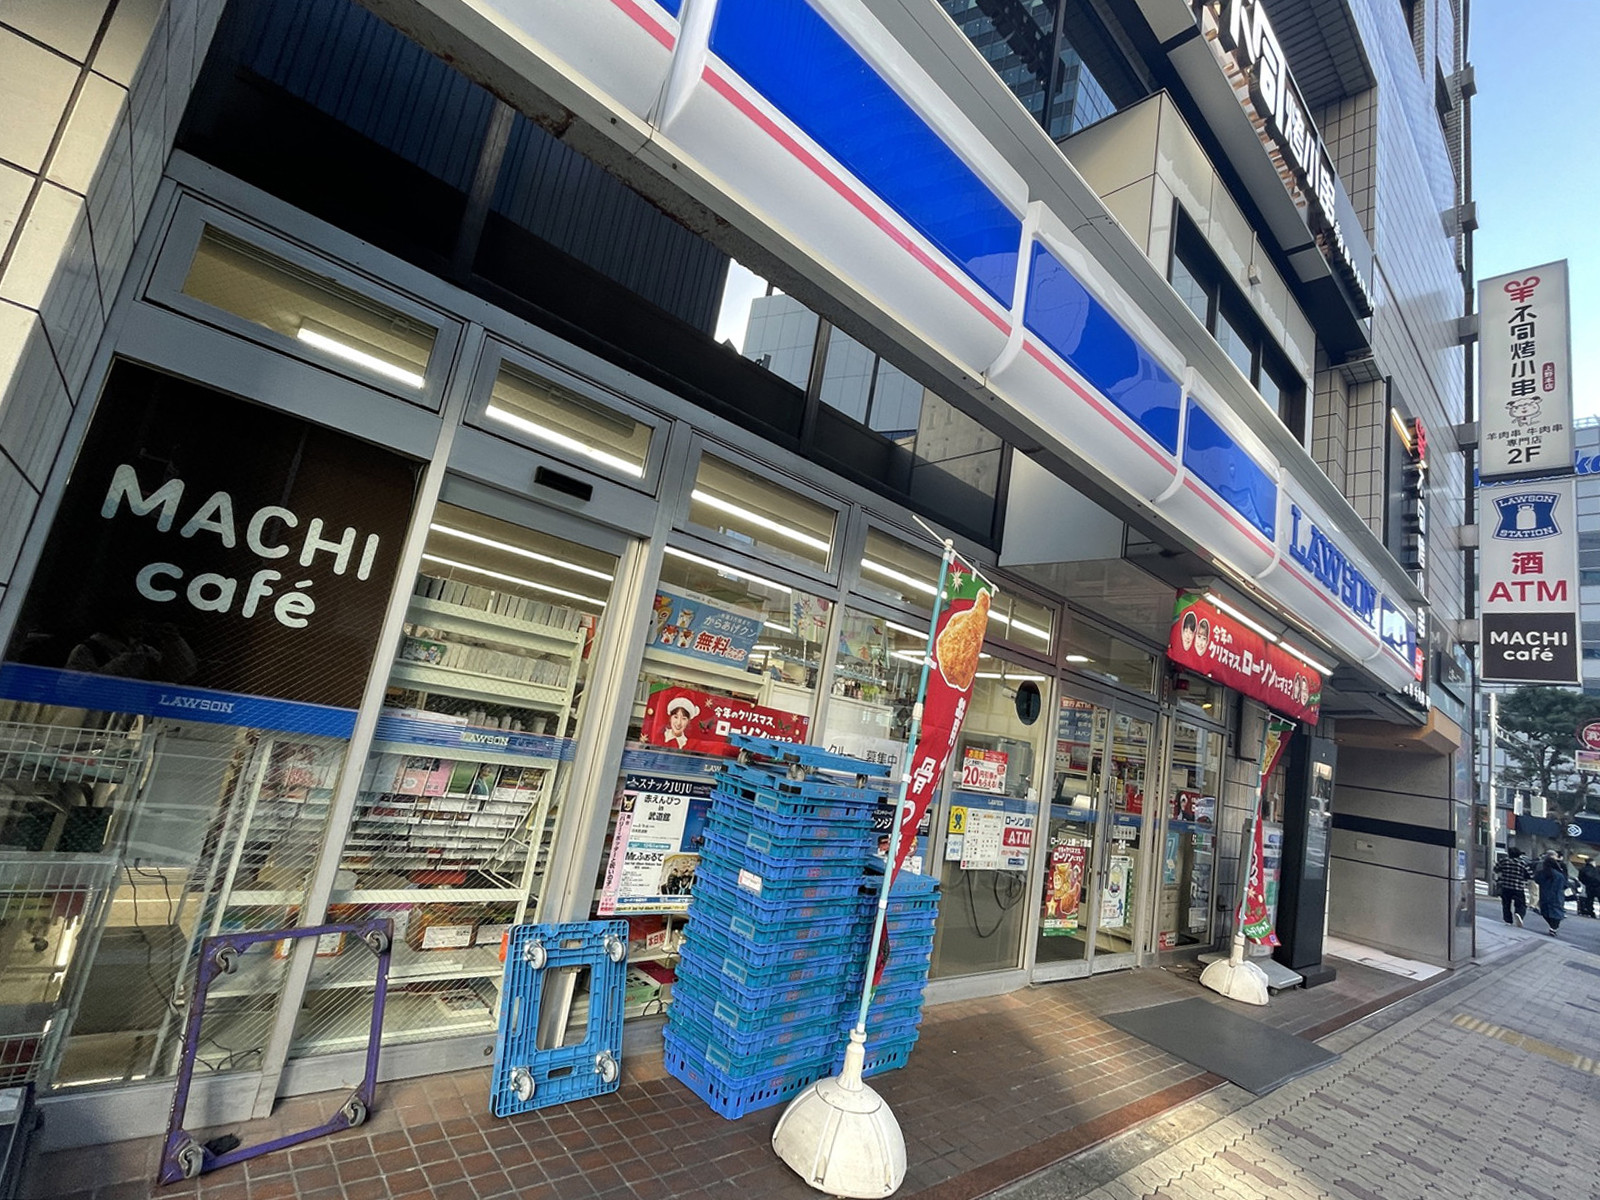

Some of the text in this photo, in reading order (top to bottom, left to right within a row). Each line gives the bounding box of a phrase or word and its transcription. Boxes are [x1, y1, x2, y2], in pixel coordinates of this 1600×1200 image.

[1508, 304, 1538, 397] 不同烤小串
[1507, 445, 1541, 465] 2F
[1498, 494, 1554, 507] LAWSON
[101, 464, 379, 581] MACHI
[1499, 526, 1554, 538] STATION
[1289, 504, 1378, 630] LAWSON
[1511, 551, 1544, 575] 酒
[136, 562, 316, 628] café
[1488, 580, 1567, 602] ATM
[703, 615, 757, 638] からあげクン
[1212, 625, 1233, 645] 今年の
[694, 631, 731, 656] 無料
[1490, 631, 1568, 646] MACHI
[1503, 647, 1554, 662] café
[160, 694, 234, 714] LAWSON
[460, 732, 509, 746] LAWSON
[866, 749, 898, 766] 募集中
[963, 765, 979, 785] 20
[639, 778, 693, 794] スナックJUJU
[1008, 831, 1031, 845] ATM
